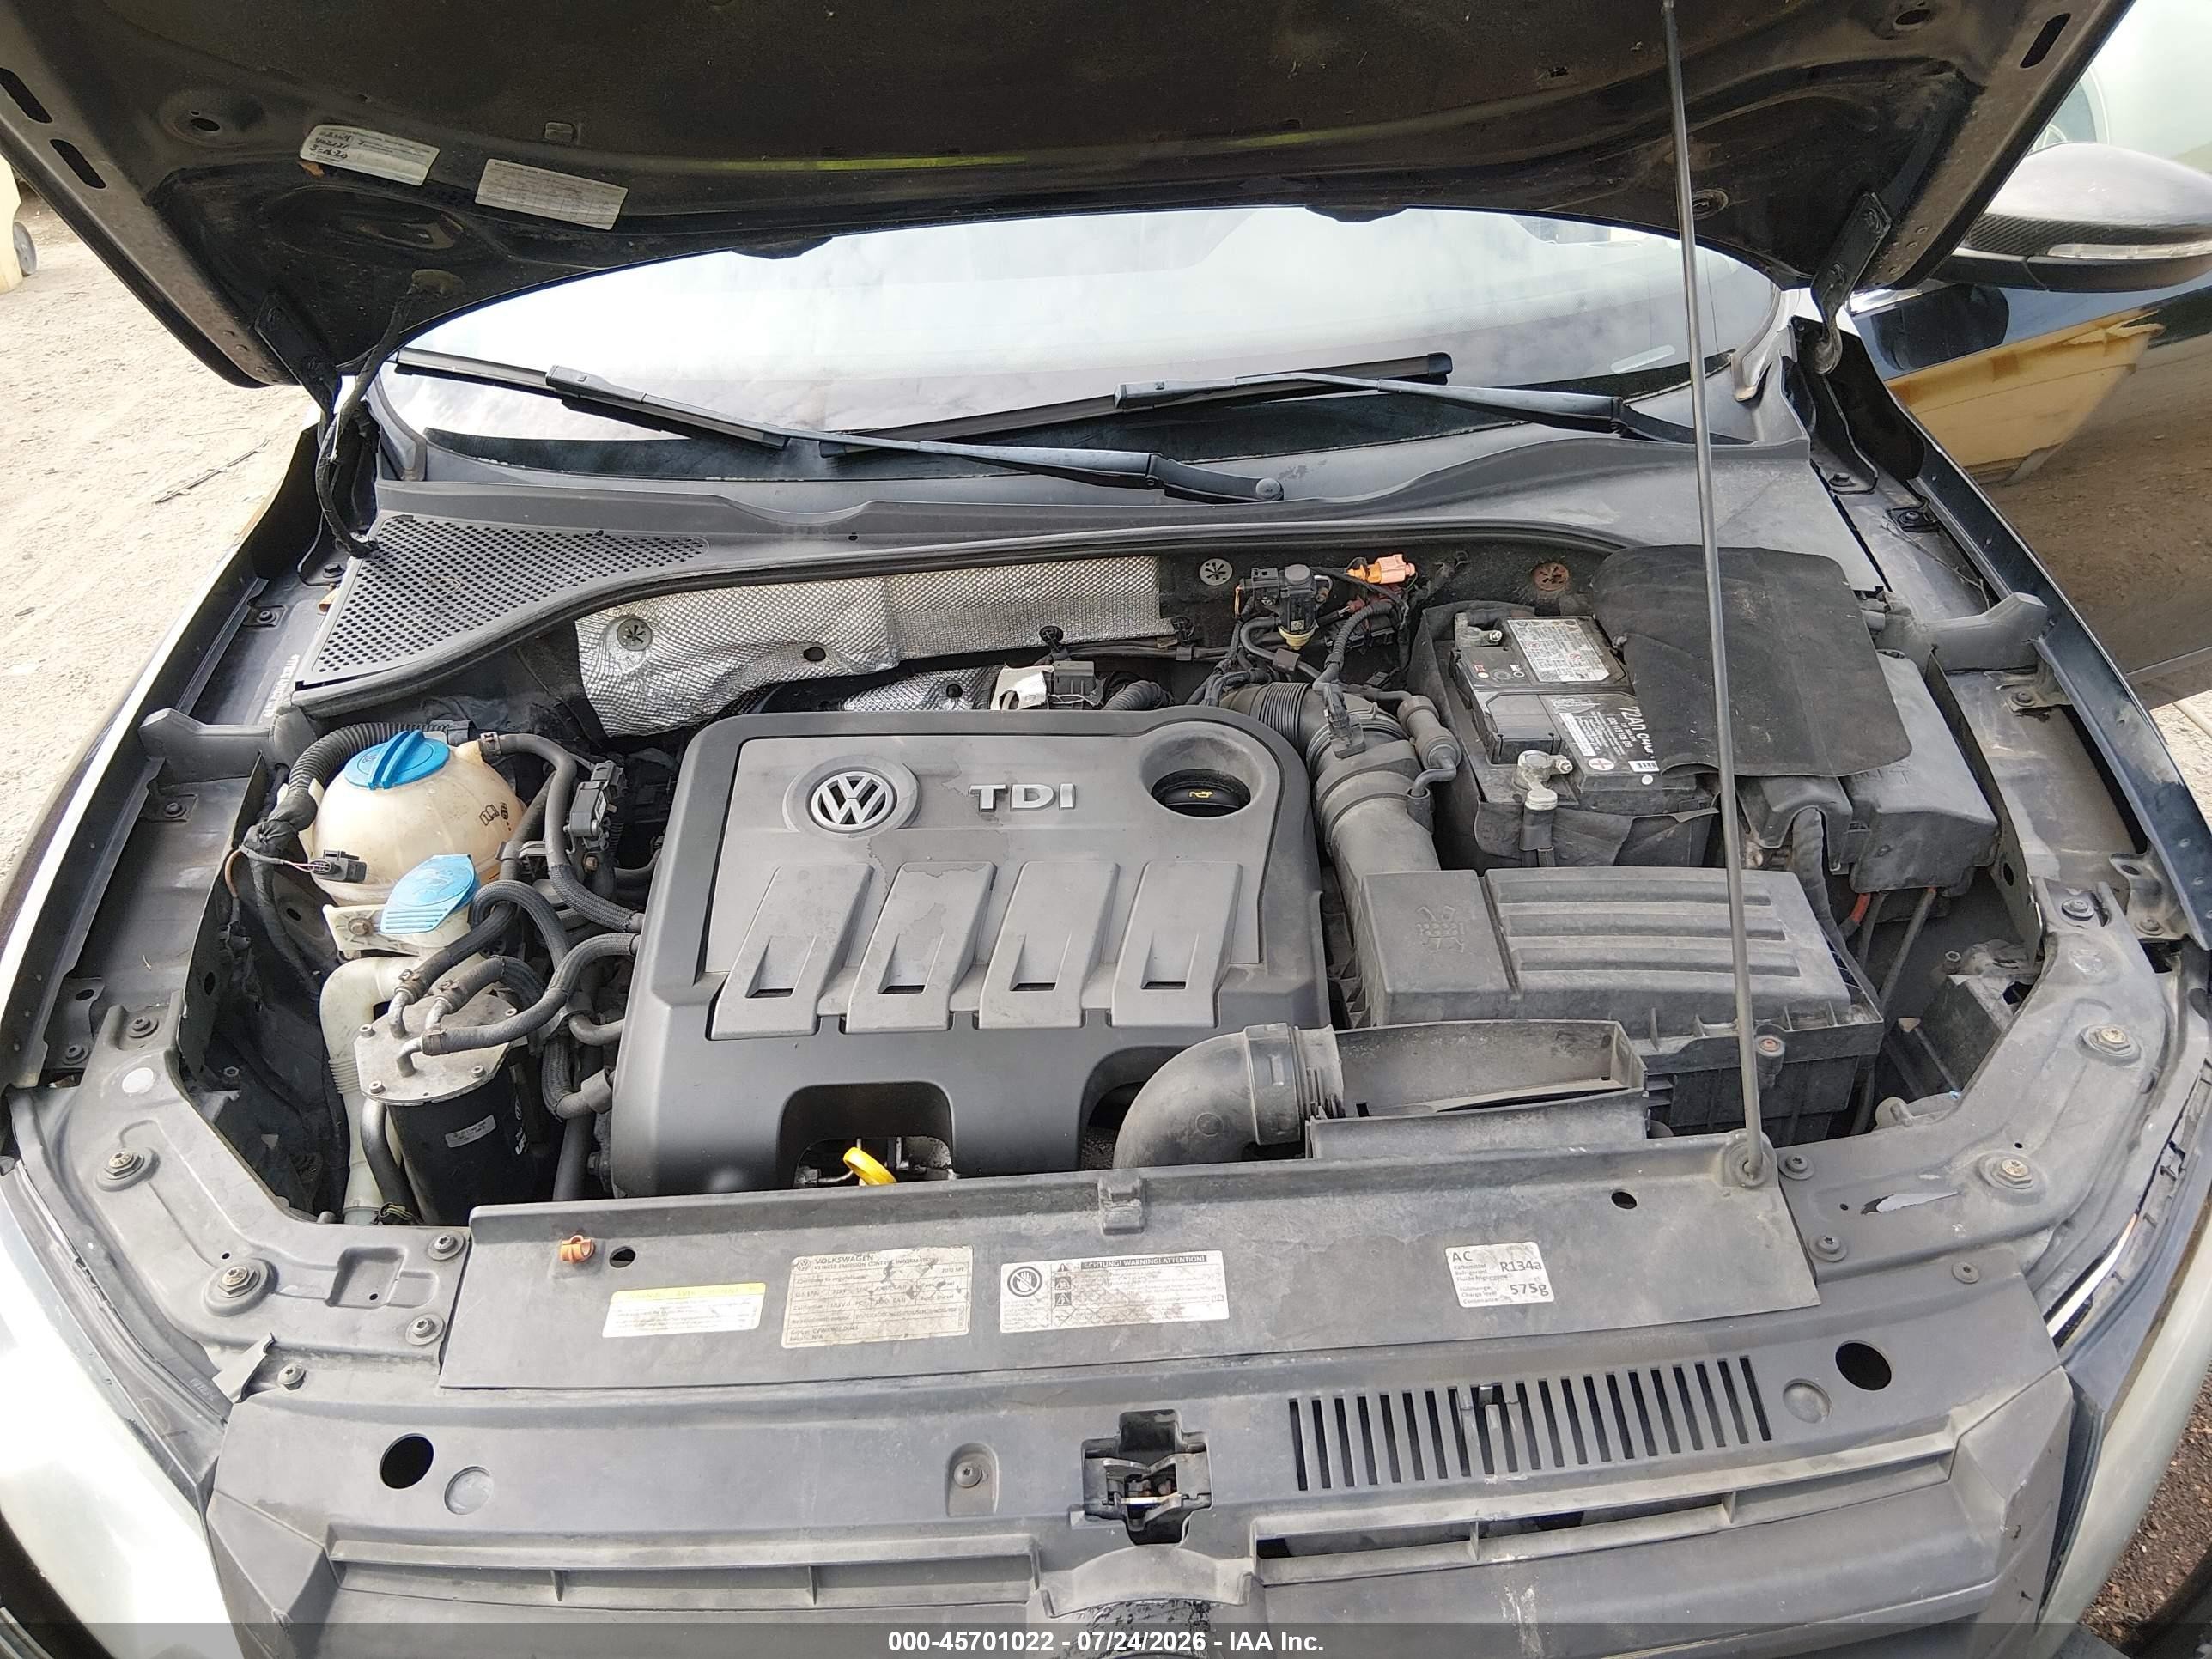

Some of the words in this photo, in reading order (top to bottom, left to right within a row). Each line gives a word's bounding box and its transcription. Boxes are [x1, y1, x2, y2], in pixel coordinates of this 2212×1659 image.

[969, 782, 1076, 812] TDI
[815, 1255, 874, 1265] VOLKSWAGEN
[1500, 1261, 1543, 1272] R134a
[1510, 1283, 1549, 1297] 575g
